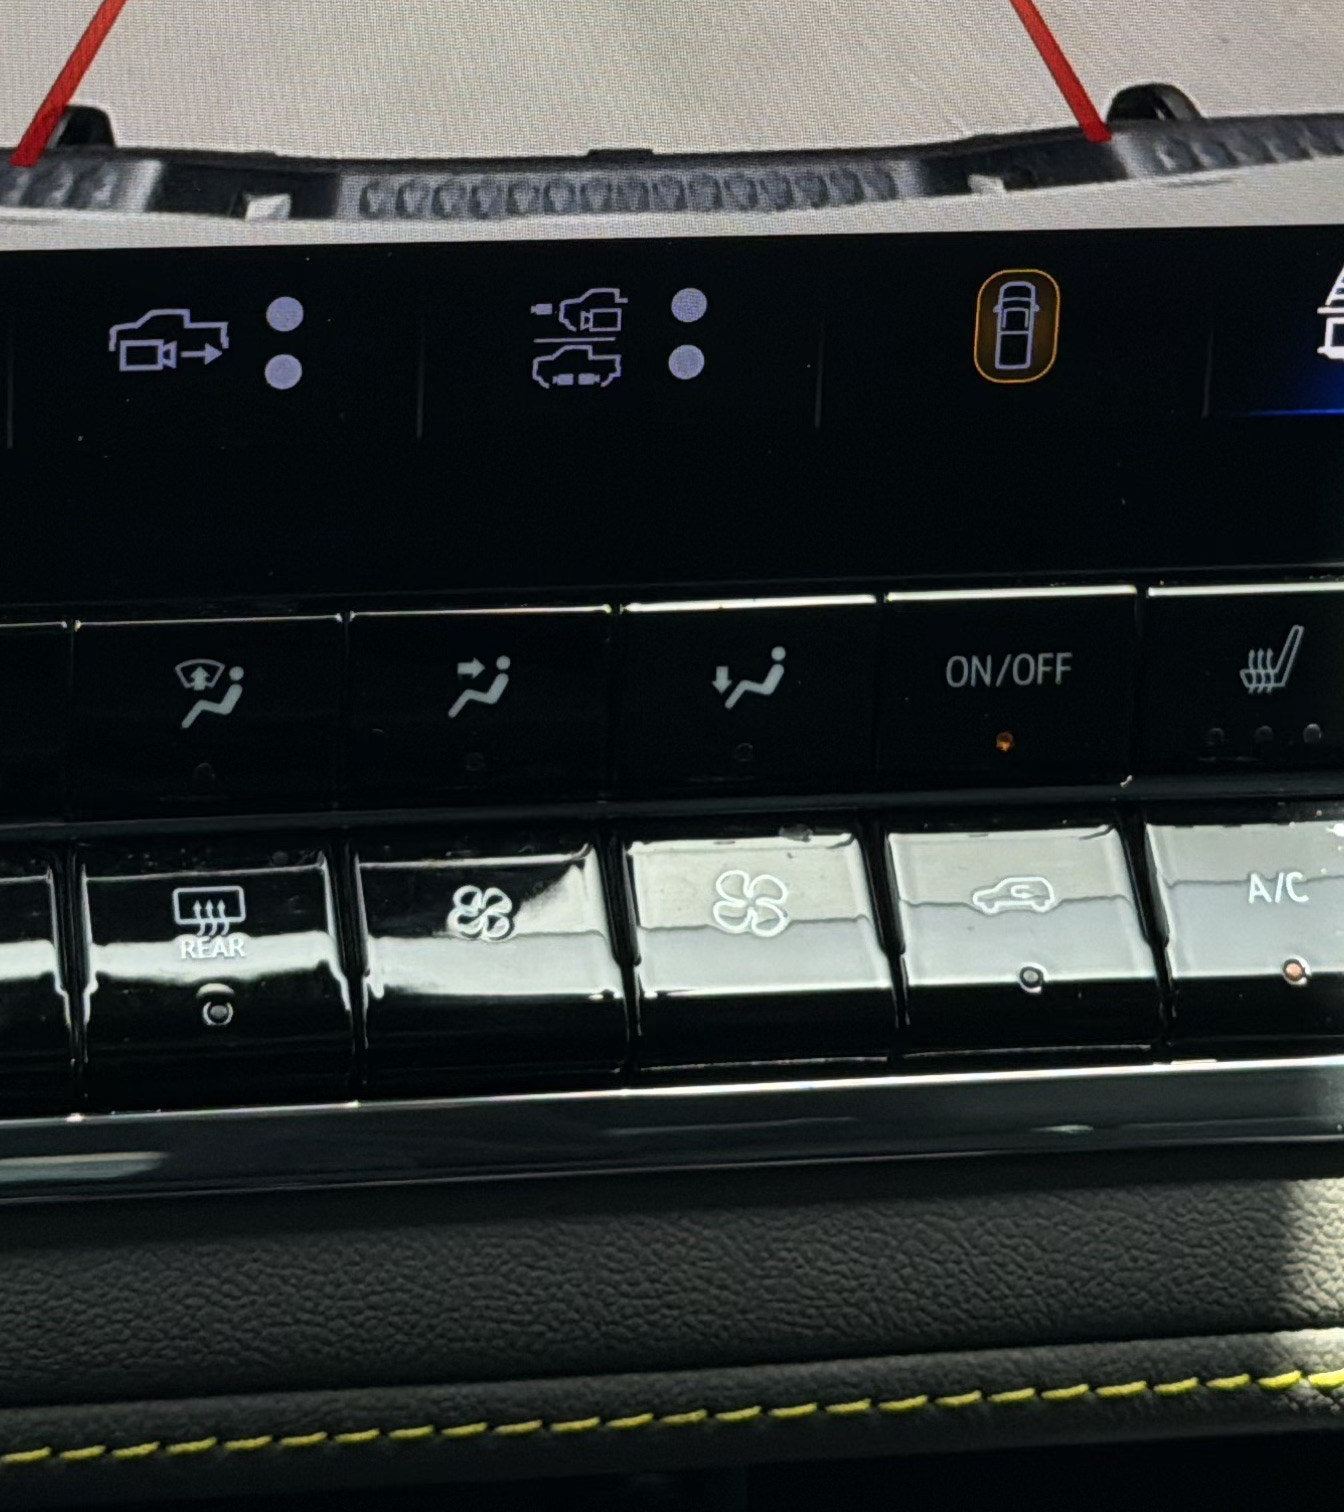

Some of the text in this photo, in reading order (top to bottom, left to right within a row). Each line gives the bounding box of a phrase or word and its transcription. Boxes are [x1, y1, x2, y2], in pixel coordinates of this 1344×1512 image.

[945, 651, 1074, 688] ON/OFF
[1247, 871, 1310, 904] A/C
[180, 934, 247, 959] REAR
